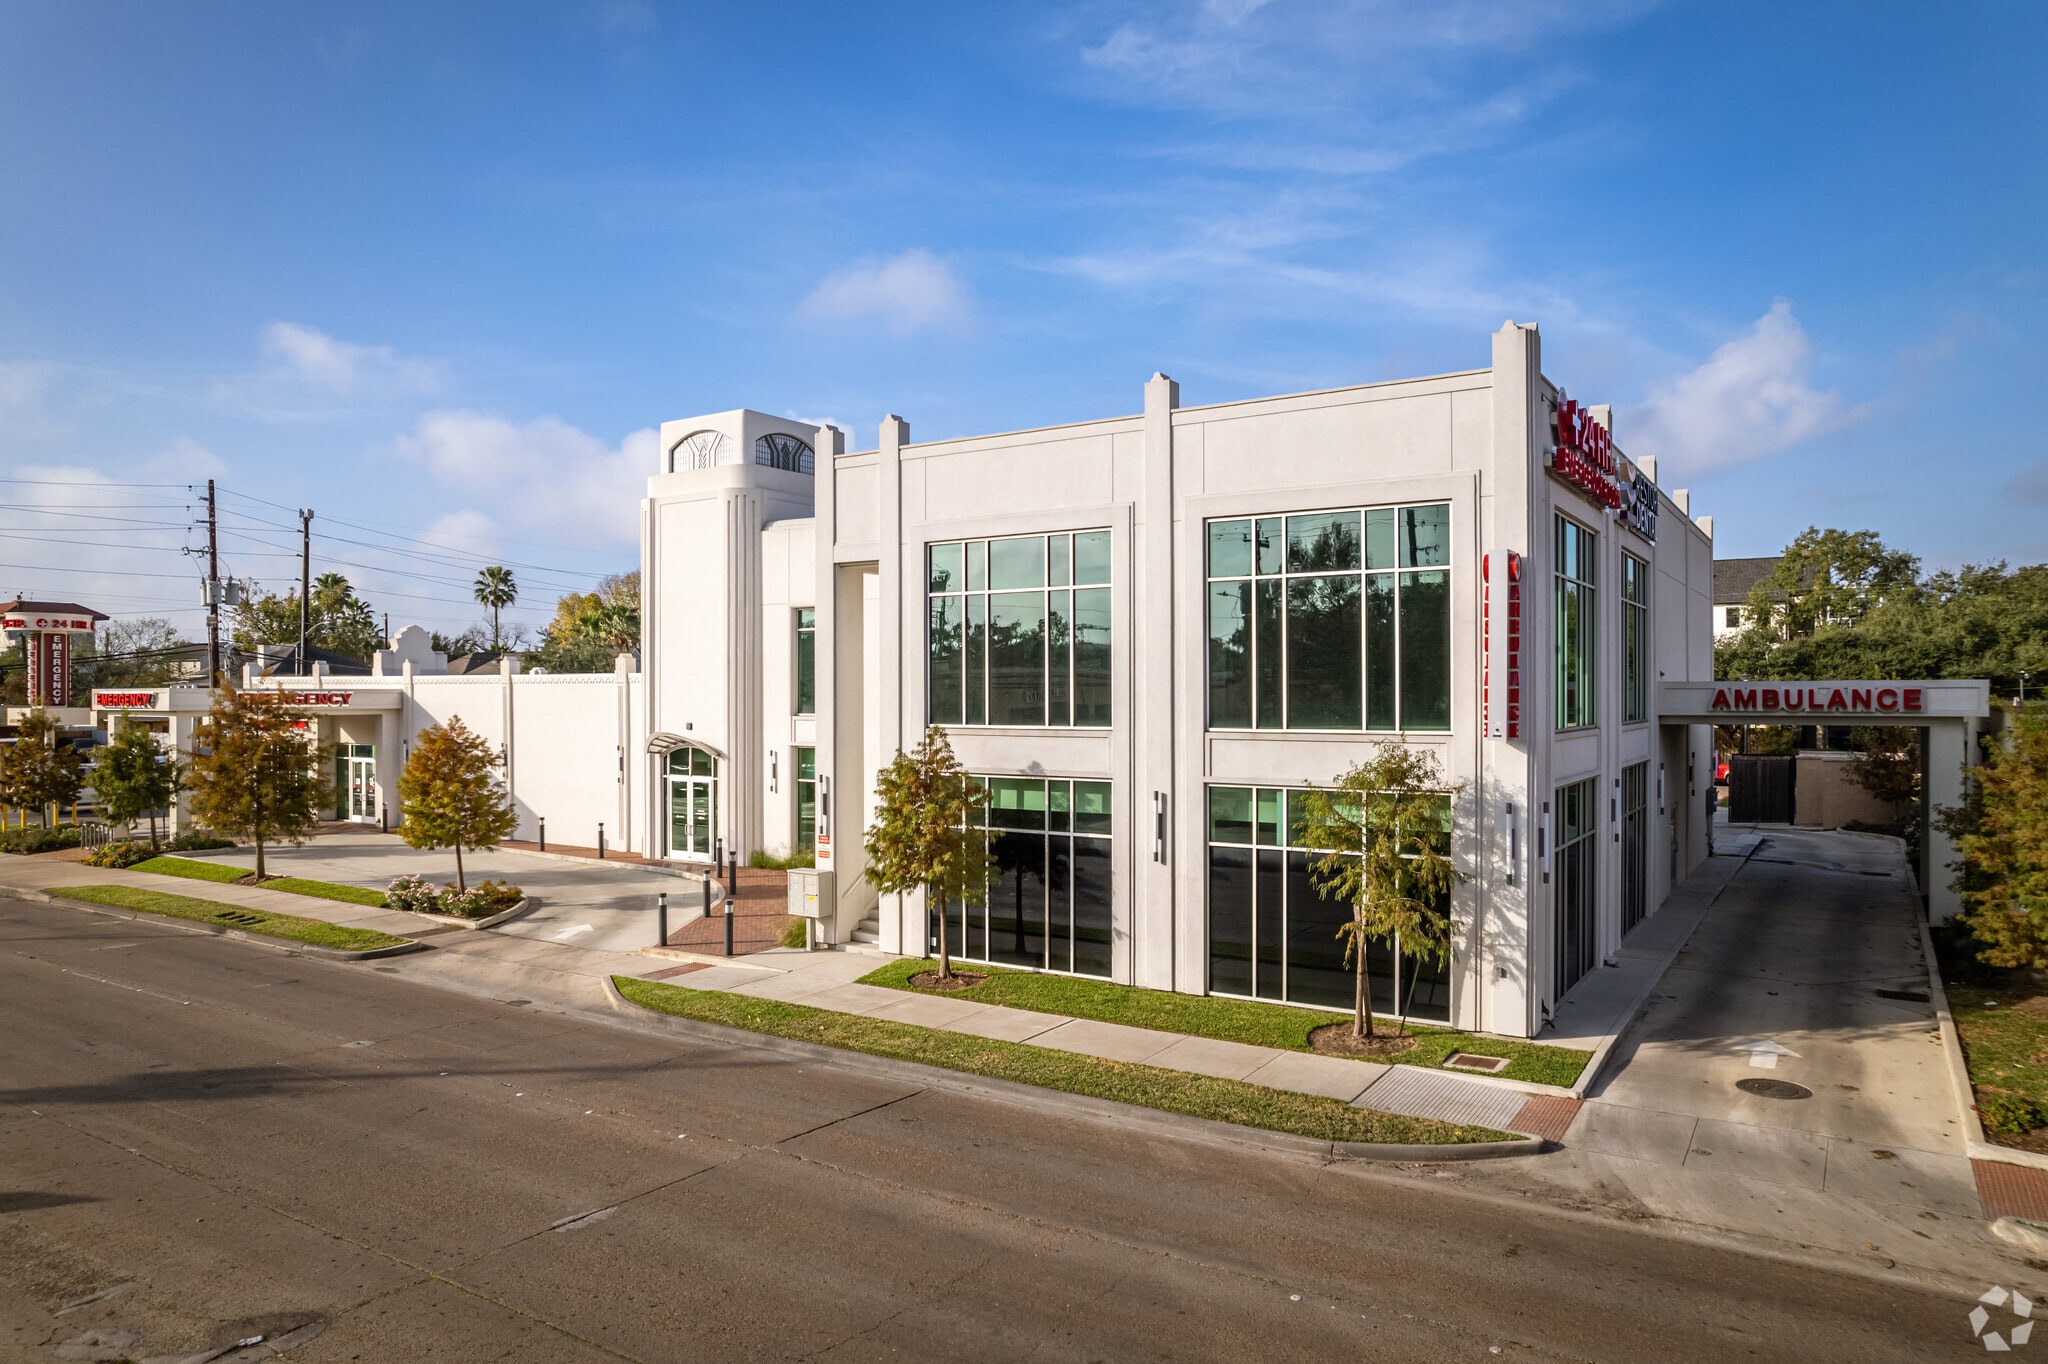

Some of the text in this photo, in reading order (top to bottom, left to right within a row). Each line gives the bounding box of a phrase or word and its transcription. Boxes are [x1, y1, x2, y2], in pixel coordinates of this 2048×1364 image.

[1579, 408, 1596, 461] 24
[52, 619, 69, 629] 24
[52, 635, 62, 704] EMERGENCY
[96, 693, 149, 707] EMERGENCY
[1711, 688, 1922, 710] AMBULANCE
